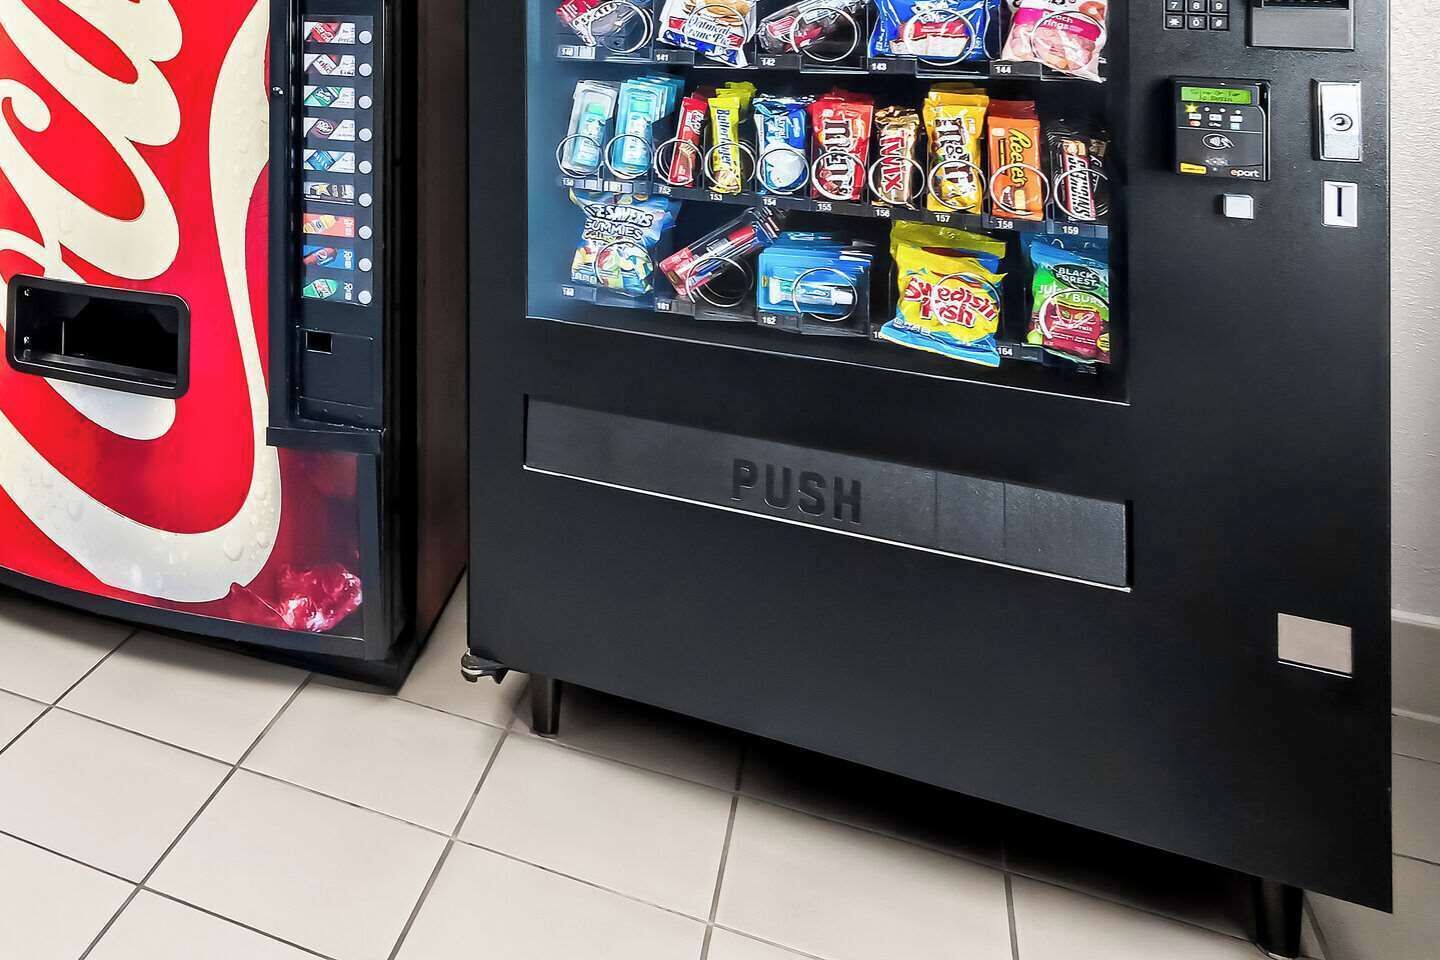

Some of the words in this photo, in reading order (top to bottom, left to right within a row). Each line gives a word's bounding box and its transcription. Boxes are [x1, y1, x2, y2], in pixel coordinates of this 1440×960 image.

[762, 58, 776, 66] 142
[995, 65, 1011, 73] 144
[716, 109, 732, 167] Butterfnger
[879, 129, 905, 192] TWIX
[1229, 169, 1261, 178] eport
[763, 199, 777, 207] 154
[817, 204, 832, 212] 155
[876, 210, 890, 218] 156
[936, 215, 951, 223] 157
[998, 221, 1013, 229] 158
[1062, 226, 1079, 234] 159
[1058, 268, 1096, 279] BLACK
[1056, 273, 1099, 286] FOREST
[904, 277, 999, 322] Swedish
[920, 297, 977, 327] Fsh
[762, 317, 777, 325] 162
[873, 331, 882, 339] 16
[998, 347, 1013, 356] 164
[731, 457, 862, 525] PUSH
